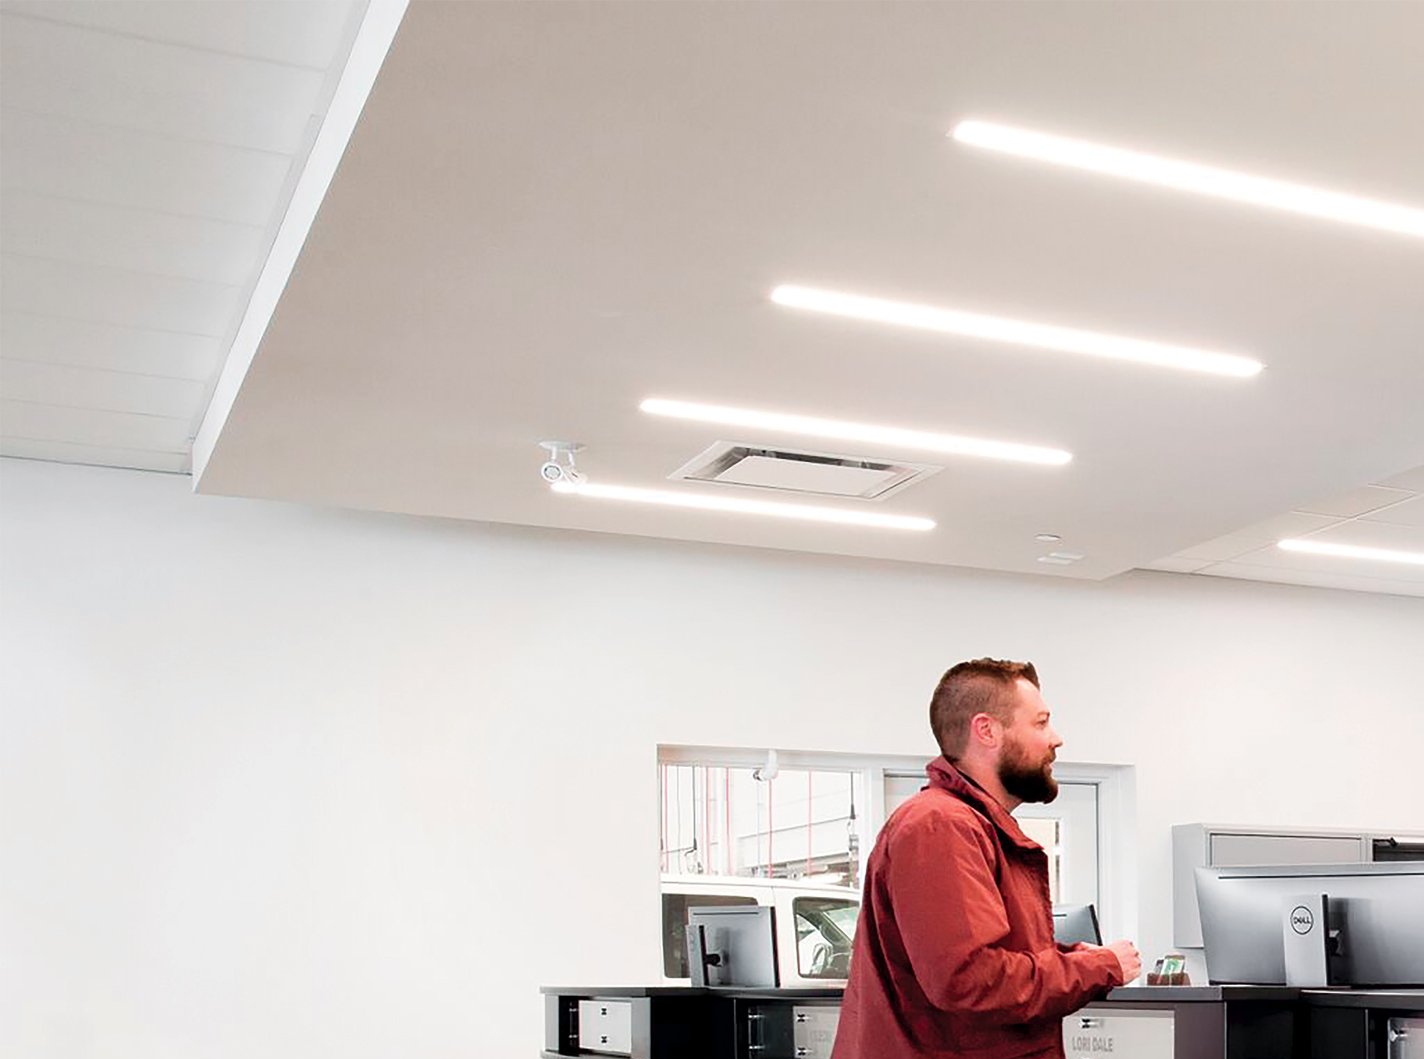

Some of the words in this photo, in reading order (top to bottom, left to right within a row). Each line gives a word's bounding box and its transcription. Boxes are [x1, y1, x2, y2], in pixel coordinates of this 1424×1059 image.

[1293, 916, 1311, 924] DELL
[1072, 1036, 1090, 1052] LORI
[1092, 1036, 1113, 1052] DALE
